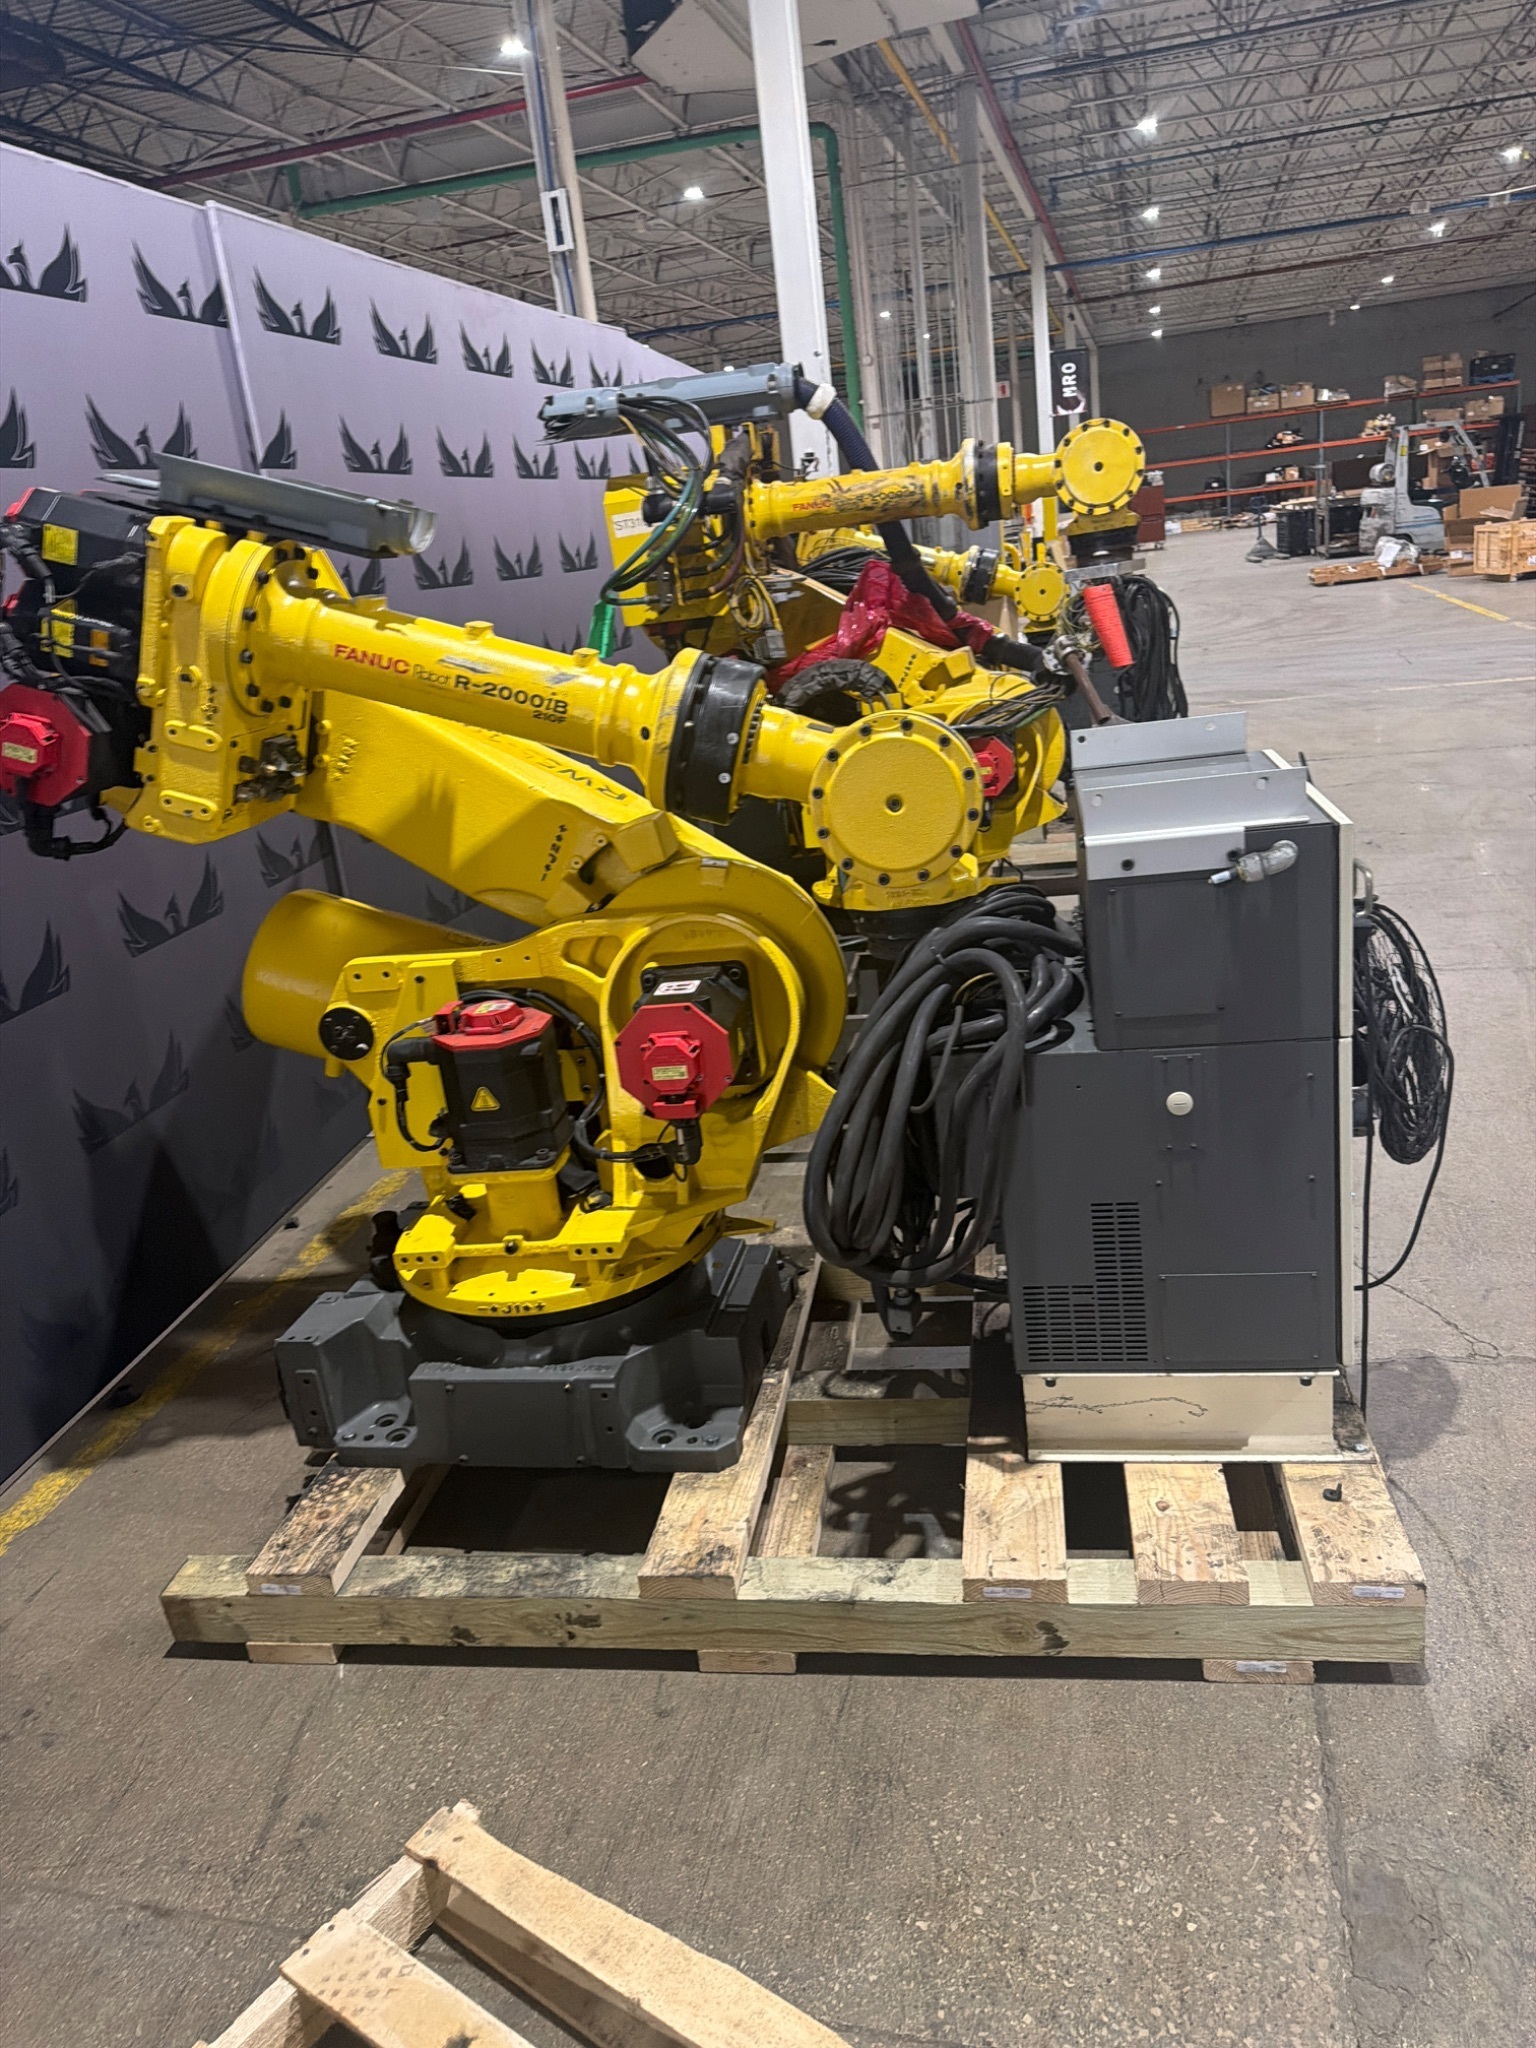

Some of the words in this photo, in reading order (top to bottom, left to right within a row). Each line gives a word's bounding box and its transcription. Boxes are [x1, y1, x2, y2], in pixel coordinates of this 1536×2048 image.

[1061, 362, 1077, 398] MRO
[334, 643, 411, 675] FANUC
[454, 674, 569, 715] R-2000iB
[532, 709, 567, 724] 210F
